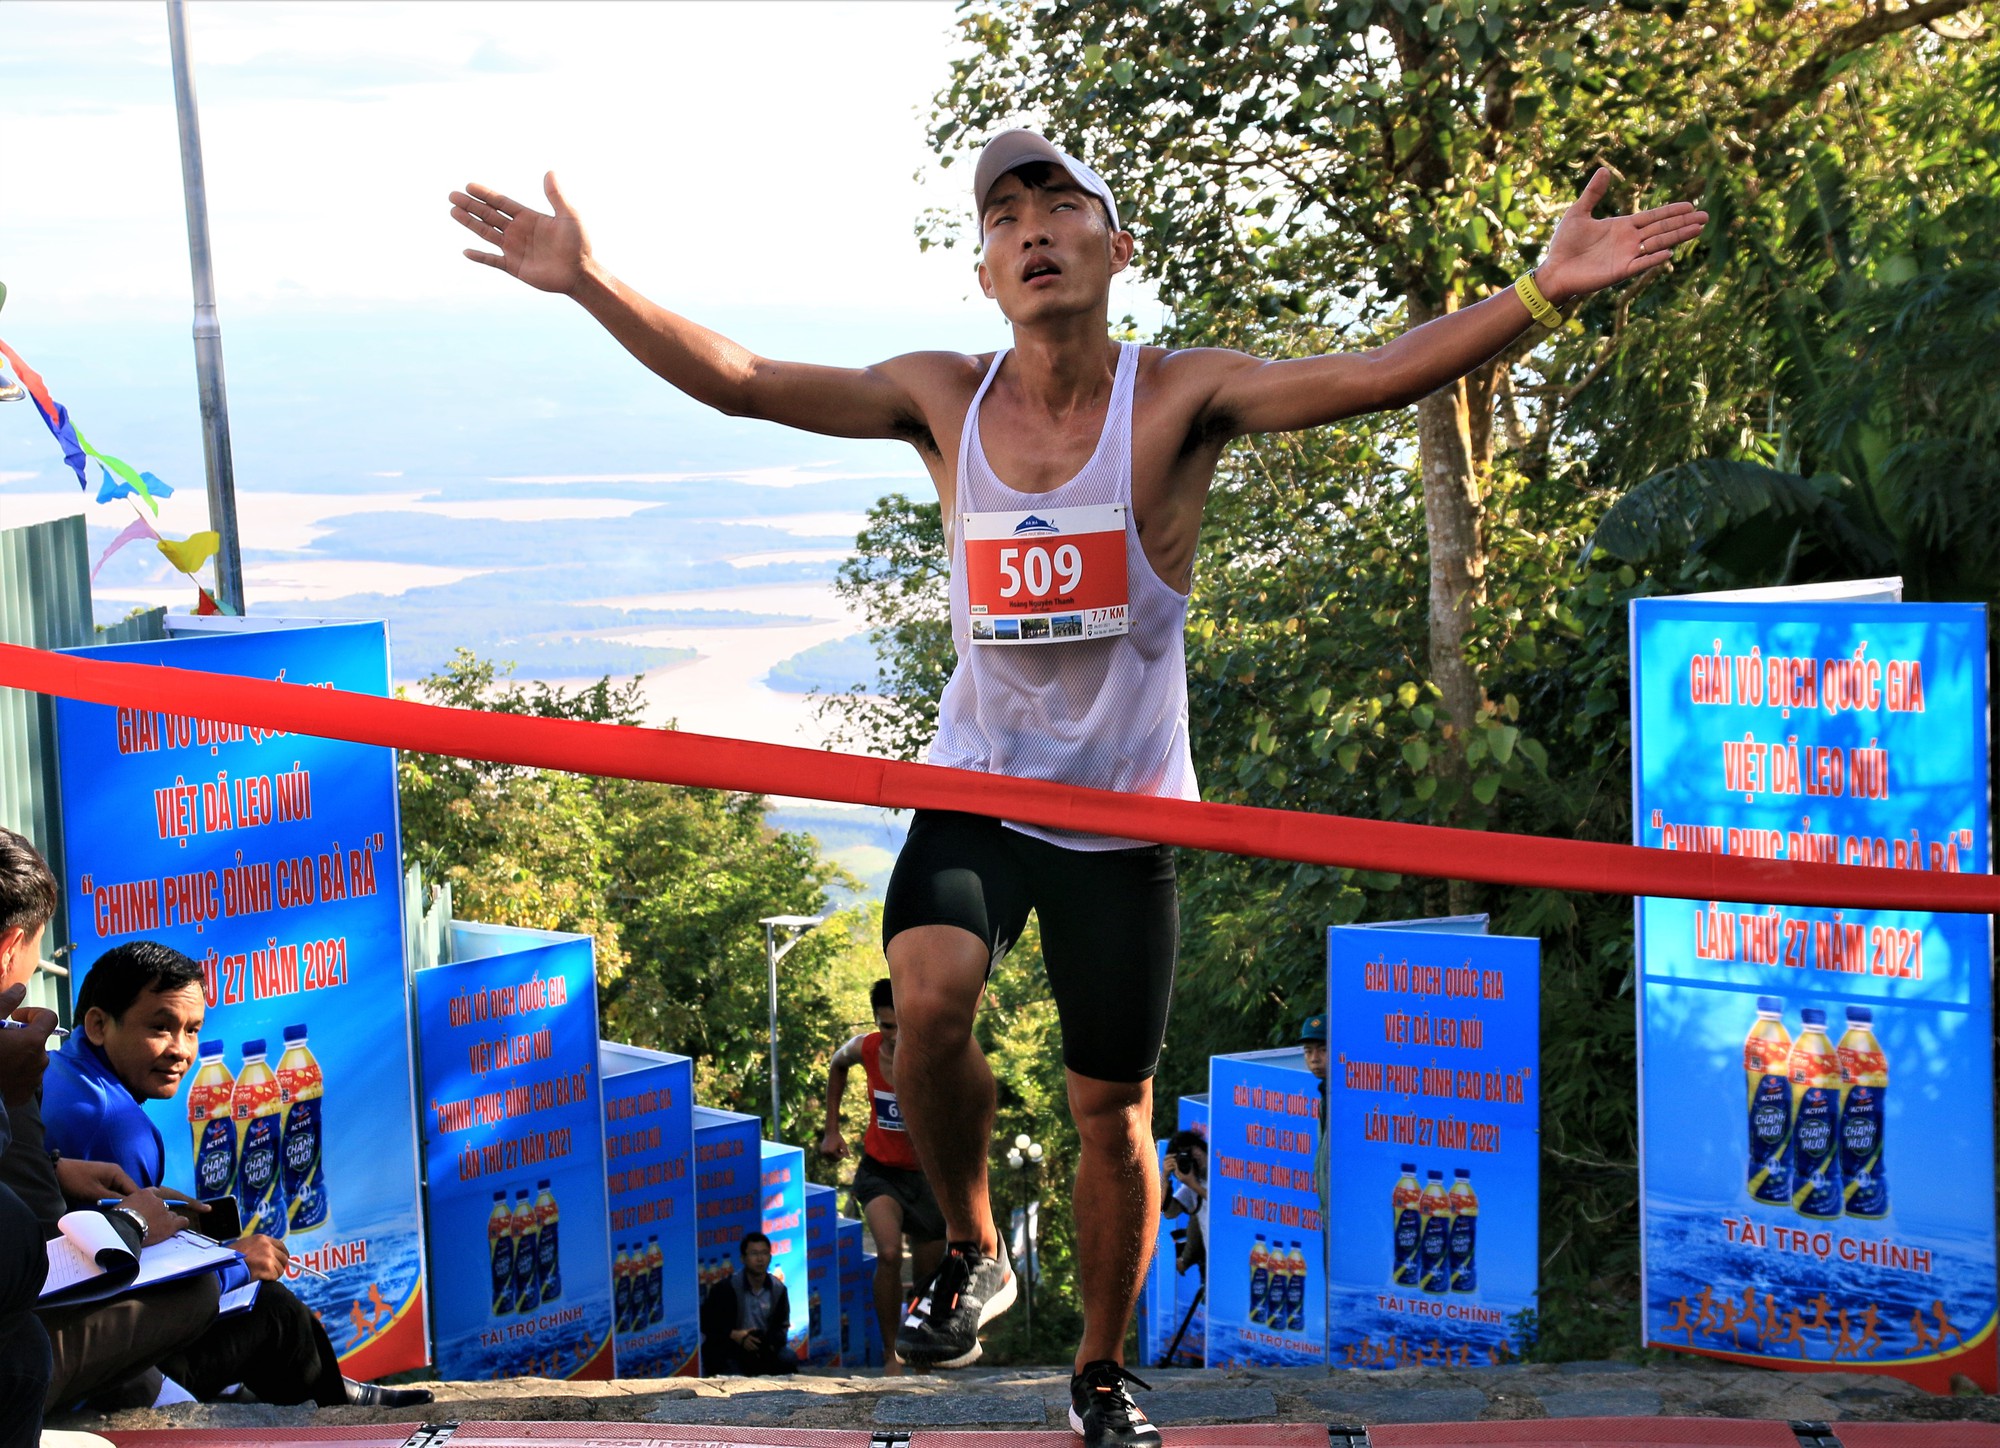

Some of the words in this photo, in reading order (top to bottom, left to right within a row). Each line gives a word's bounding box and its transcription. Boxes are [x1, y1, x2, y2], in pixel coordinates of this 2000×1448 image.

[1000, 544, 1083, 598] 509
[1092, 609, 1108, 623] 7,7
[1109, 606, 1125, 619] KM
[1690, 639, 1732, 705] GIẢI
[1736, 646, 1763, 706] VÔ
[1768, 655, 1818, 718] ĐỊCH
[1823, 641, 1881, 715] QUỐC
[1886, 659, 1925, 713] GIA
[1723, 732, 1767, 803] VIỆT
[1772, 735, 1801, 795] DÃ
[1806, 745, 1844, 798] LEO
[1851, 738, 1888, 800] NÚI
[155, 775, 198, 847] VIỆT
[204, 771, 231, 833] DÃ
[235, 776, 273, 829] LEO
[278, 762, 312, 823] NÚI
[1740, 905, 1782, 966] THỨ
[1784, 919, 1809, 968] 27
[1816, 913, 1866, 975] NĂM
[1871, 925, 1923, 980] 2021
[223, 953, 245, 1005] 27
[252, 938, 298, 1001] NĂM
[303, 937, 348, 991] 2021
[1365, 953, 1390, 992] GIẢI
[1393, 960, 1409, 993] VÔ
[1412, 966, 1441, 1000] ĐỊCH
[1445, 958, 1479, 999] QUỐC
[1483, 970, 1504, 1000] GIA
[449, 986, 472, 1028] GIẢI
[474, 986, 489, 1022] VÔ
[490, 985, 515, 1024] ĐỊCH
[517, 970, 546, 1016] QUỐC
[548, 975, 567, 1008] GIA
[1384, 1009, 1411, 1049] VIỆT
[1414, 1011, 1431, 1045] DÃ
[1434, 1017, 1457, 1048] LEO
[1460, 1014, 1483, 1049] NÚI
[469, 1038, 492, 1079] VIỆT
[494, 1032, 510, 1070] DÃ
[512, 1034, 530, 1066] LEO
[533, 1024, 553, 1060] NÚI
[474, 1092, 503, 1130] PHỤC
[504, 1079, 531, 1119] ĐỈNH
[533, 1079, 554, 1112] CAO
[556, 1071, 572, 1107] BÀ
[1386, 1065, 1419, 1100] PHỤC
[1422, 1058, 1453, 1097] ĐỈNH
[1457, 1071, 1481, 1100] CAO
[1485, 1067, 1503, 1102] BÀ
[291, 1117, 311, 1131] ACTIVE
[1311, 1098, 1320, 1119] GI
[206, 1134, 227, 1149] ACTIVE
[249, 1133, 270, 1148] ACTIVE
[286, 1134, 315, 1157] CHANH
[482, 1137, 504, 1175] THỨ
[505, 1140, 518, 1170] 27
[520, 1129, 546, 1166] NĂM
[548, 1127, 573, 1160] 2021
[1392, 1110, 1417, 1146] THỨ
[1418, 1118, 1434, 1147] 27
[1437, 1114, 1467, 1150] NĂM
[1470, 1123, 1501, 1153] 2021
[201, 1151, 231, 1175] CHANH
[244, 1151, 274, 1175] CHANH
[285, 1239, 367, 1280] CHÍNH
[1722, 1216, 1766, 1248] TÀI
[1774, 1227, 1833, 1261] TRỢ
[1839, 1237, 1932, 1273] CHÍNH
[480, 1328, 503, 1348] TÀI
[507, 1319, 537, 1341] TRỢ
[538, 1306, 583, 1333] CHÍNH
[1377, 1294, 1404, 1313] TÀI
[1409, 1298, 1442, 1319] TRỢ
[1445, 1304, 1501, 1324] CHÍNH
